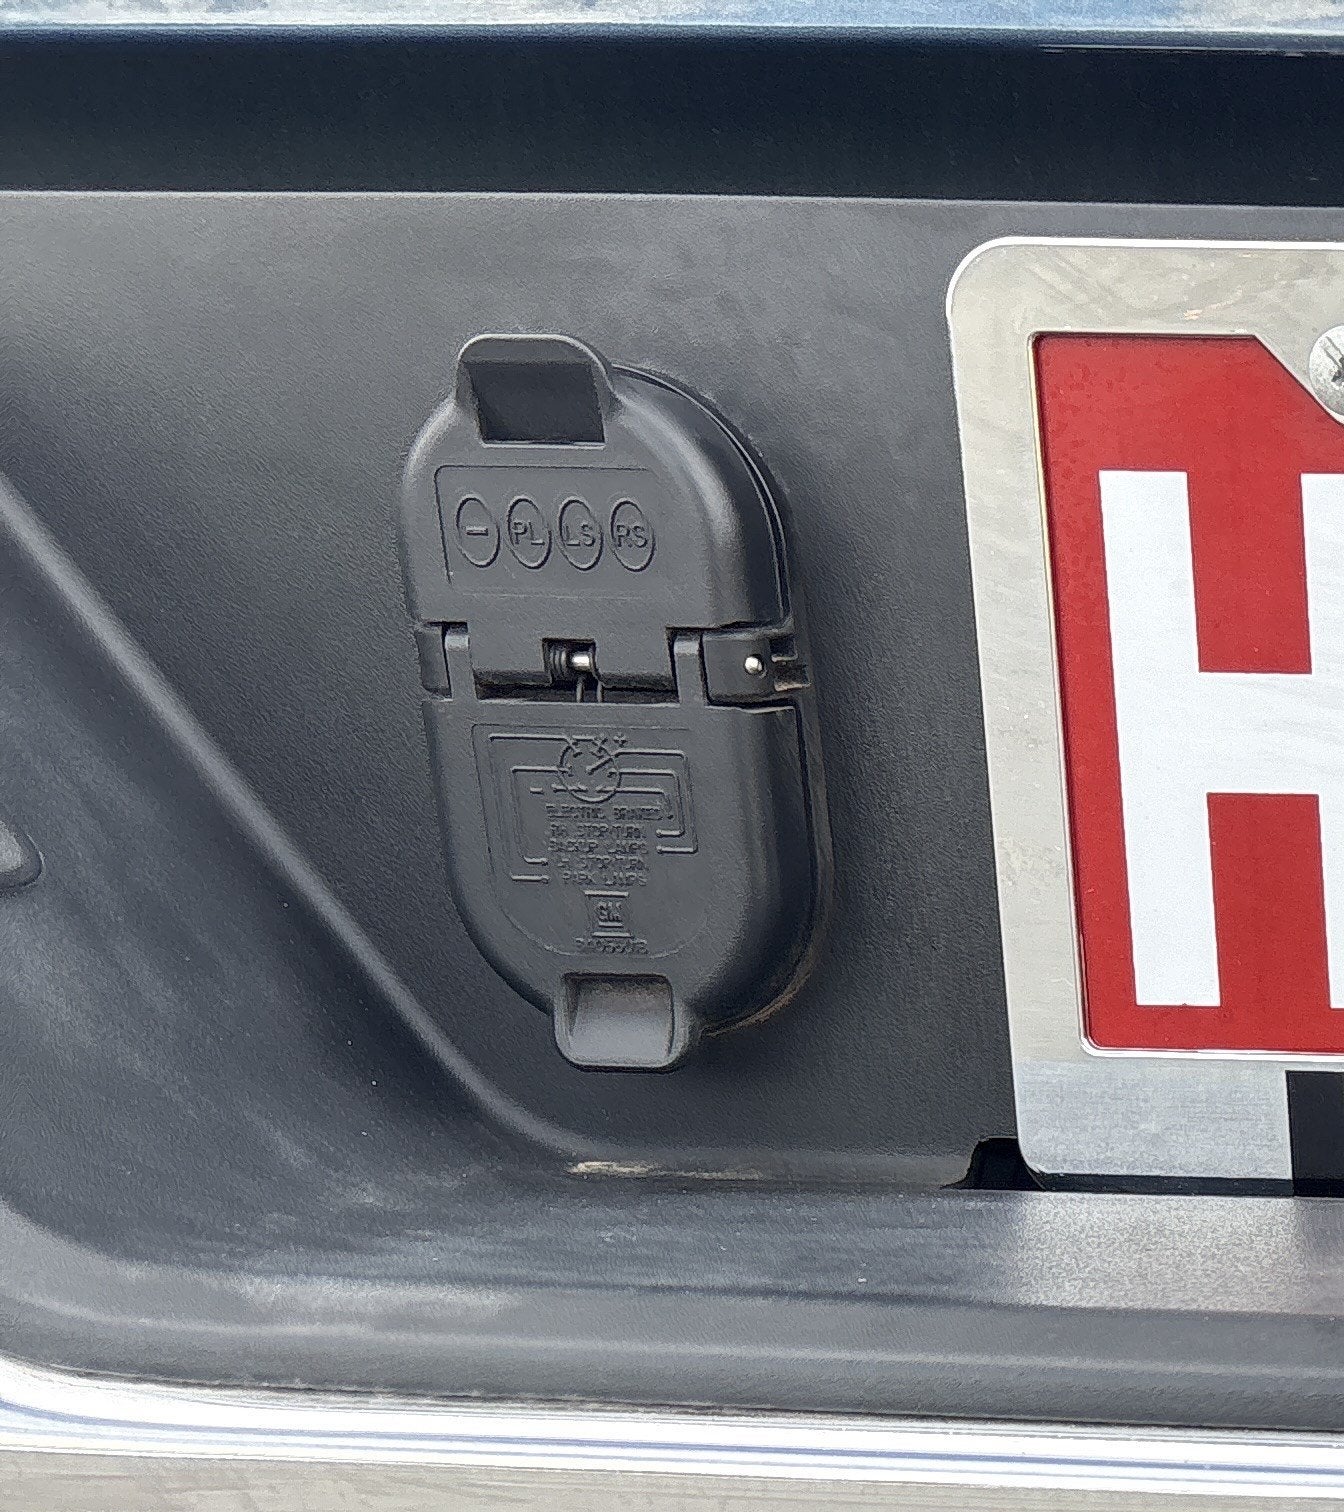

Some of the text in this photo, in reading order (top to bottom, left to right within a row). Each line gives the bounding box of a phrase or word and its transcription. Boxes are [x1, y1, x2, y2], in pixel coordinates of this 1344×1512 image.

[513, 521, 546, 545] PL
[564, 523, 597, 547] LS
[616, 524, 649, 549] RS
